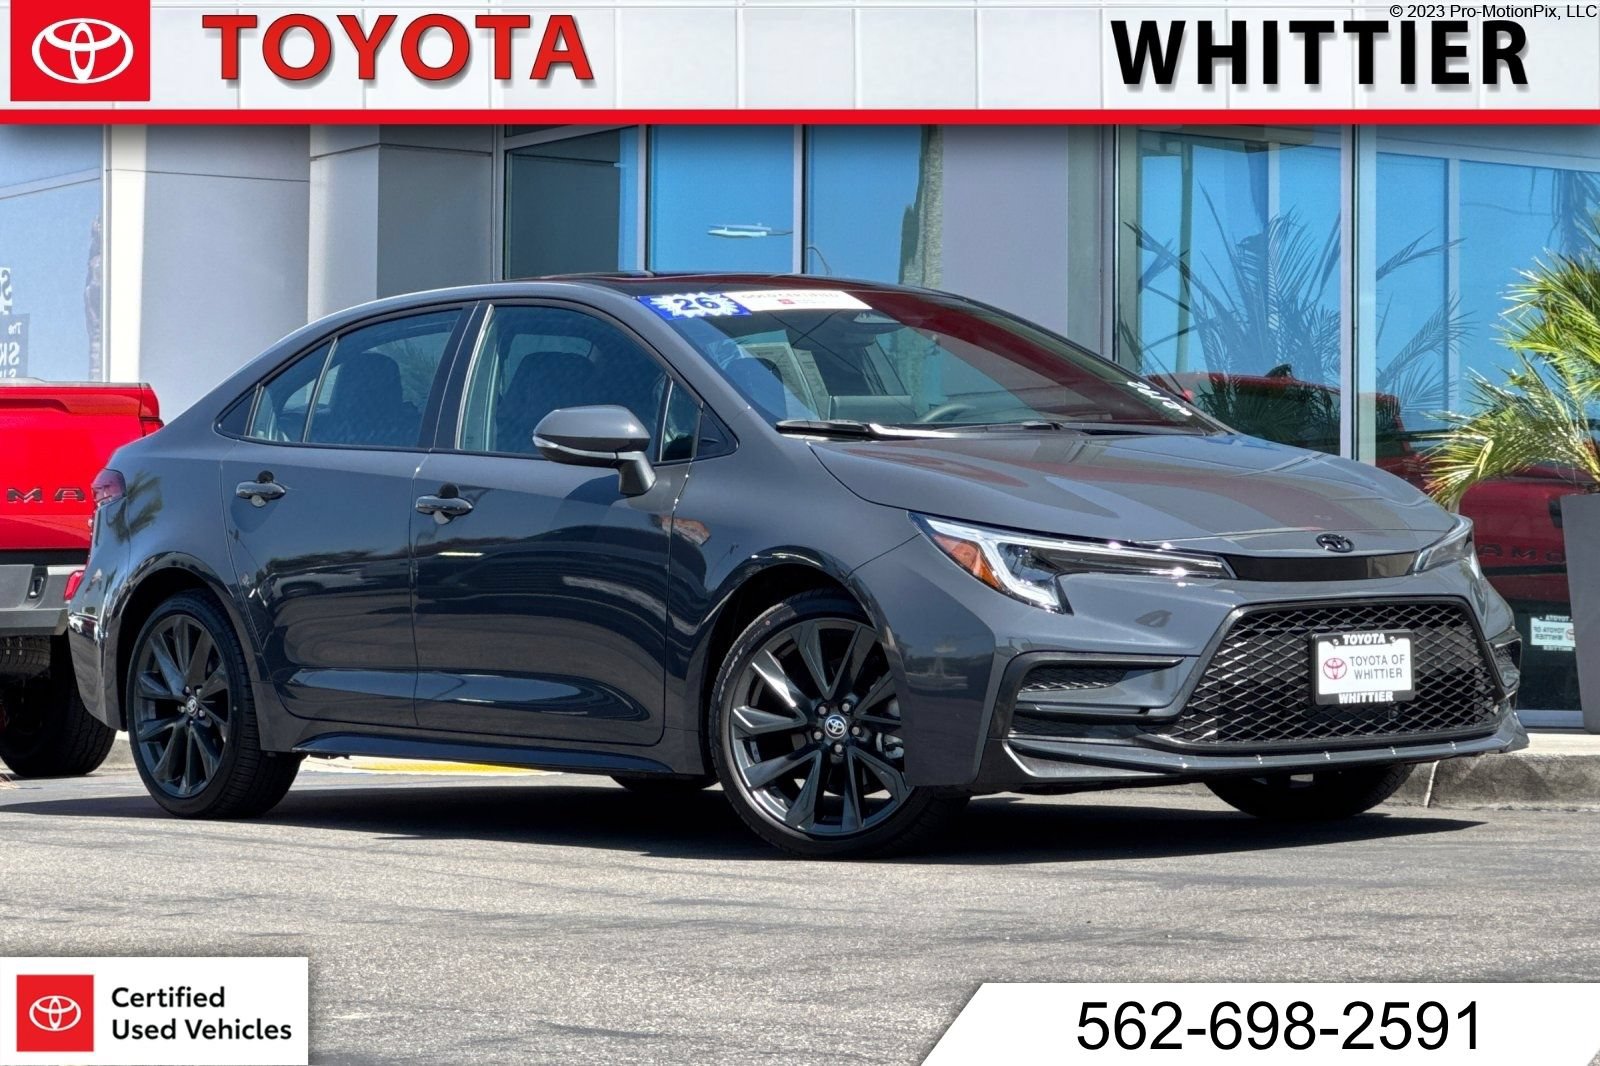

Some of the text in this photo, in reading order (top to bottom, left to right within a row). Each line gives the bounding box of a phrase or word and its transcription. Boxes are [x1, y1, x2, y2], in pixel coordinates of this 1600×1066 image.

[673, 297, 721, 310] 26
[1342, 633, 1386, 645] TOYOTA
[1349, 654, 1405, 666] TOYOTA OF
[1354, 668, 1403, 680] WHITTIER
[1338, 690, 1394, 704] WHITTIER
